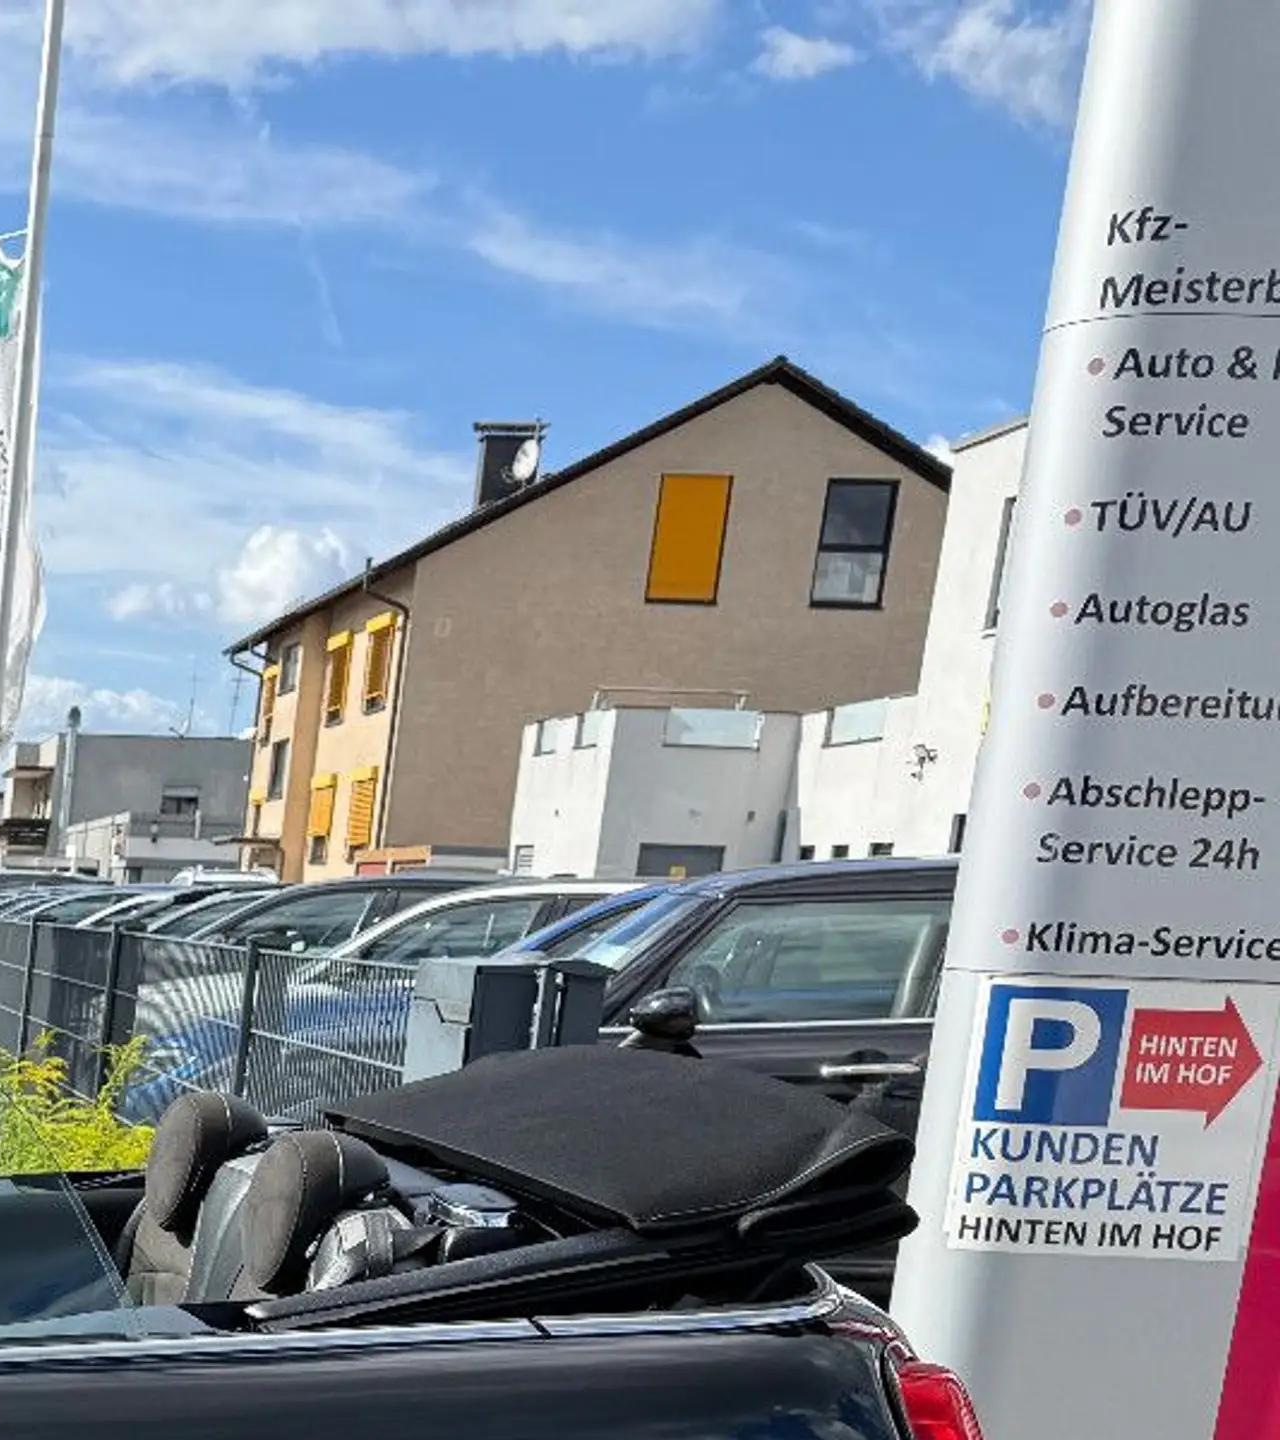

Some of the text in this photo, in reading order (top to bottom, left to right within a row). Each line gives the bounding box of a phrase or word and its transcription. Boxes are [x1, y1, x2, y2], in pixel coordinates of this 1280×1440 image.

[1107, 207, 1189, 246] Kfz-
[1113, 347, 1214, 380] Auto
[1227, 346, 1257, 380] &
[1101, 404, 1250, 438] Service
[1091, 493, 1252, 538] TÜV/AU
[1074, 593, 1250, 632] Autoglas
[1047, 776, 1266, 818] Abschlepp-
[1036, 833, 1260, 870] Service 24h
[1026, 922, 1280, 961] Klima-Service
[994, 998, 1101, 1111] P
[1139, 1034, 1238, 1058] HINTEN
[1135, 1063, 1233, 1086] IM HOF
[971, 1127, 1159, 1167] KUNDEN
[965, 1171, 1229, 1216] PARKPLÄTZE
[958, 1214, 1222, 1252] HINTEN IM HOF
